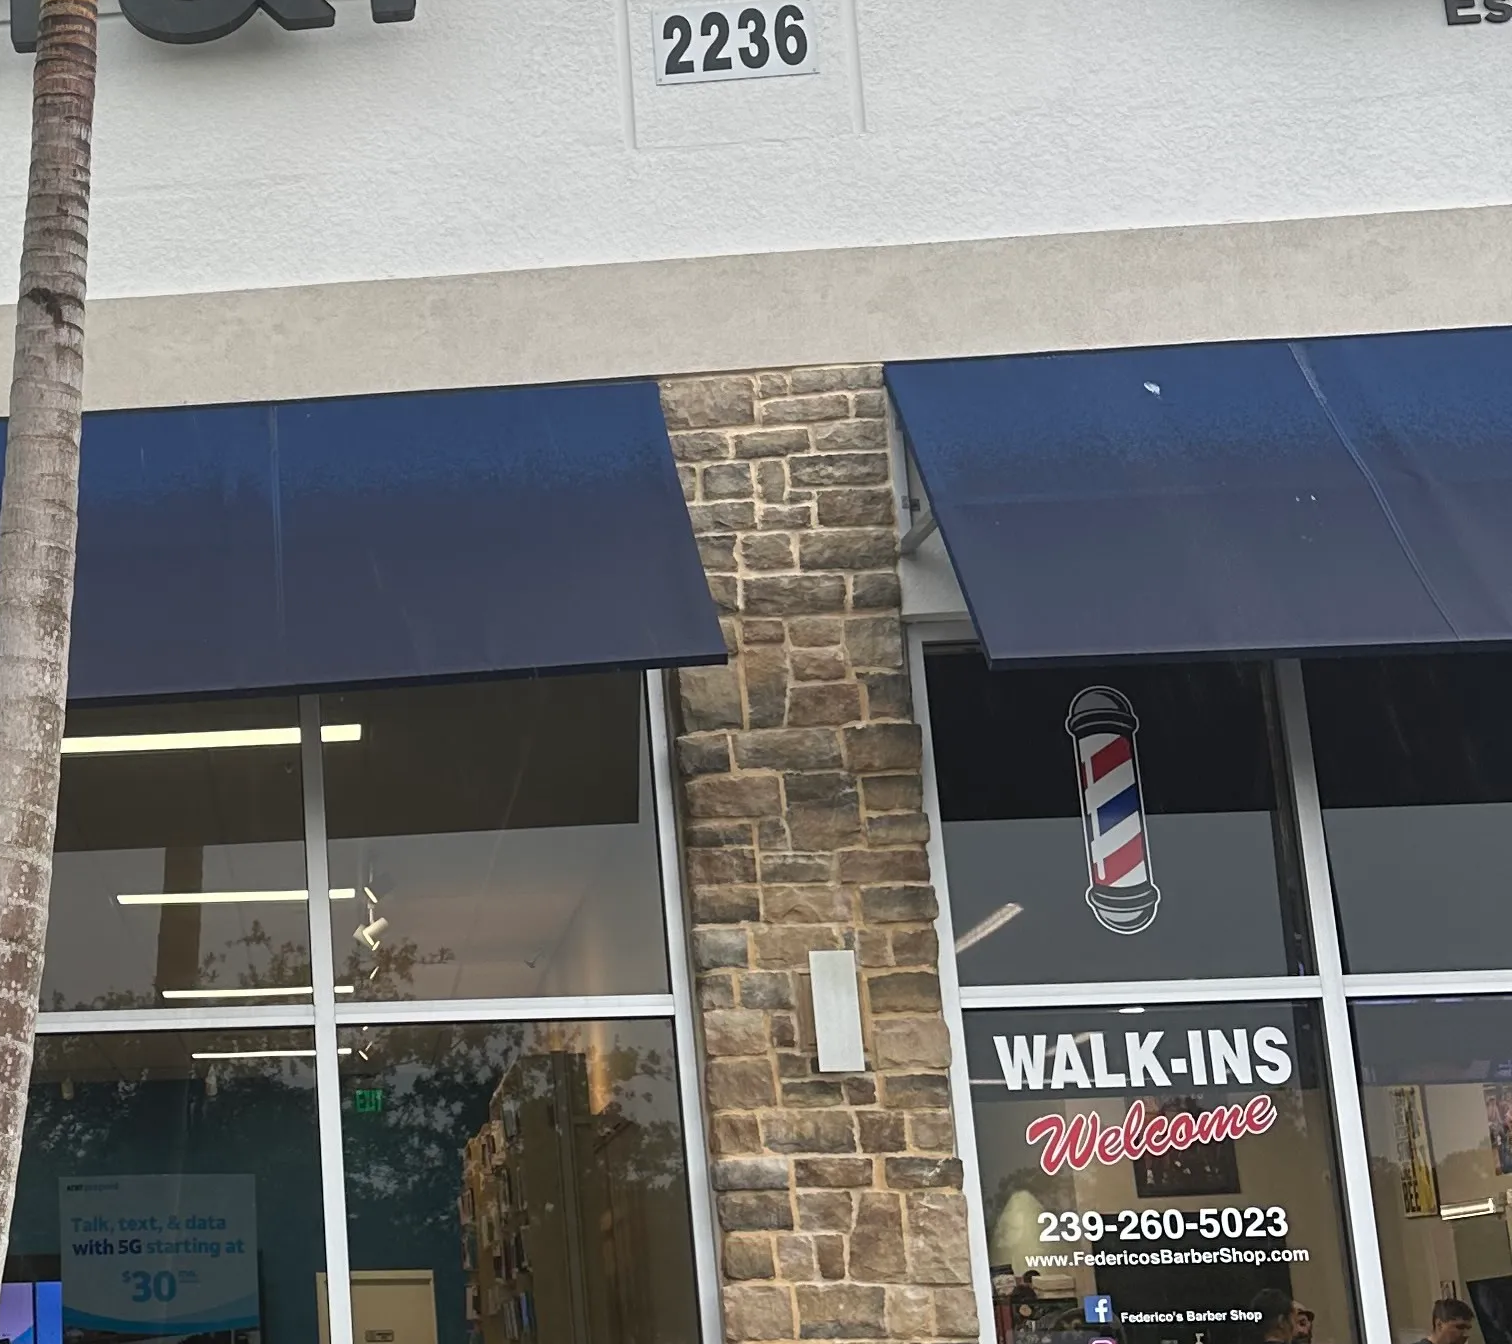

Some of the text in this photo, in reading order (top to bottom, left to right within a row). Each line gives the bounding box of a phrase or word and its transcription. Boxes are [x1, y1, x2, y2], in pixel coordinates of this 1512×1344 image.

[661, 4, 808, 75] 2236
[993, 1025, 1292, 1091] WALK-INS
[1025, 1094, 1278, 1176] Welcome
[70, 1215, 226, 1234] Talk, text, & data
[1037, 1206, 1289, 1243] 239-260-5023
[73, 1237, 245, 1258] with 5G starting at
[1025, 1246, 1310, 1268] www.FedericosBarberShop.com
[121, 1269, 177, 1303] $30
[1121, 1308, 1263, 1324] Federico's Barber Shop
